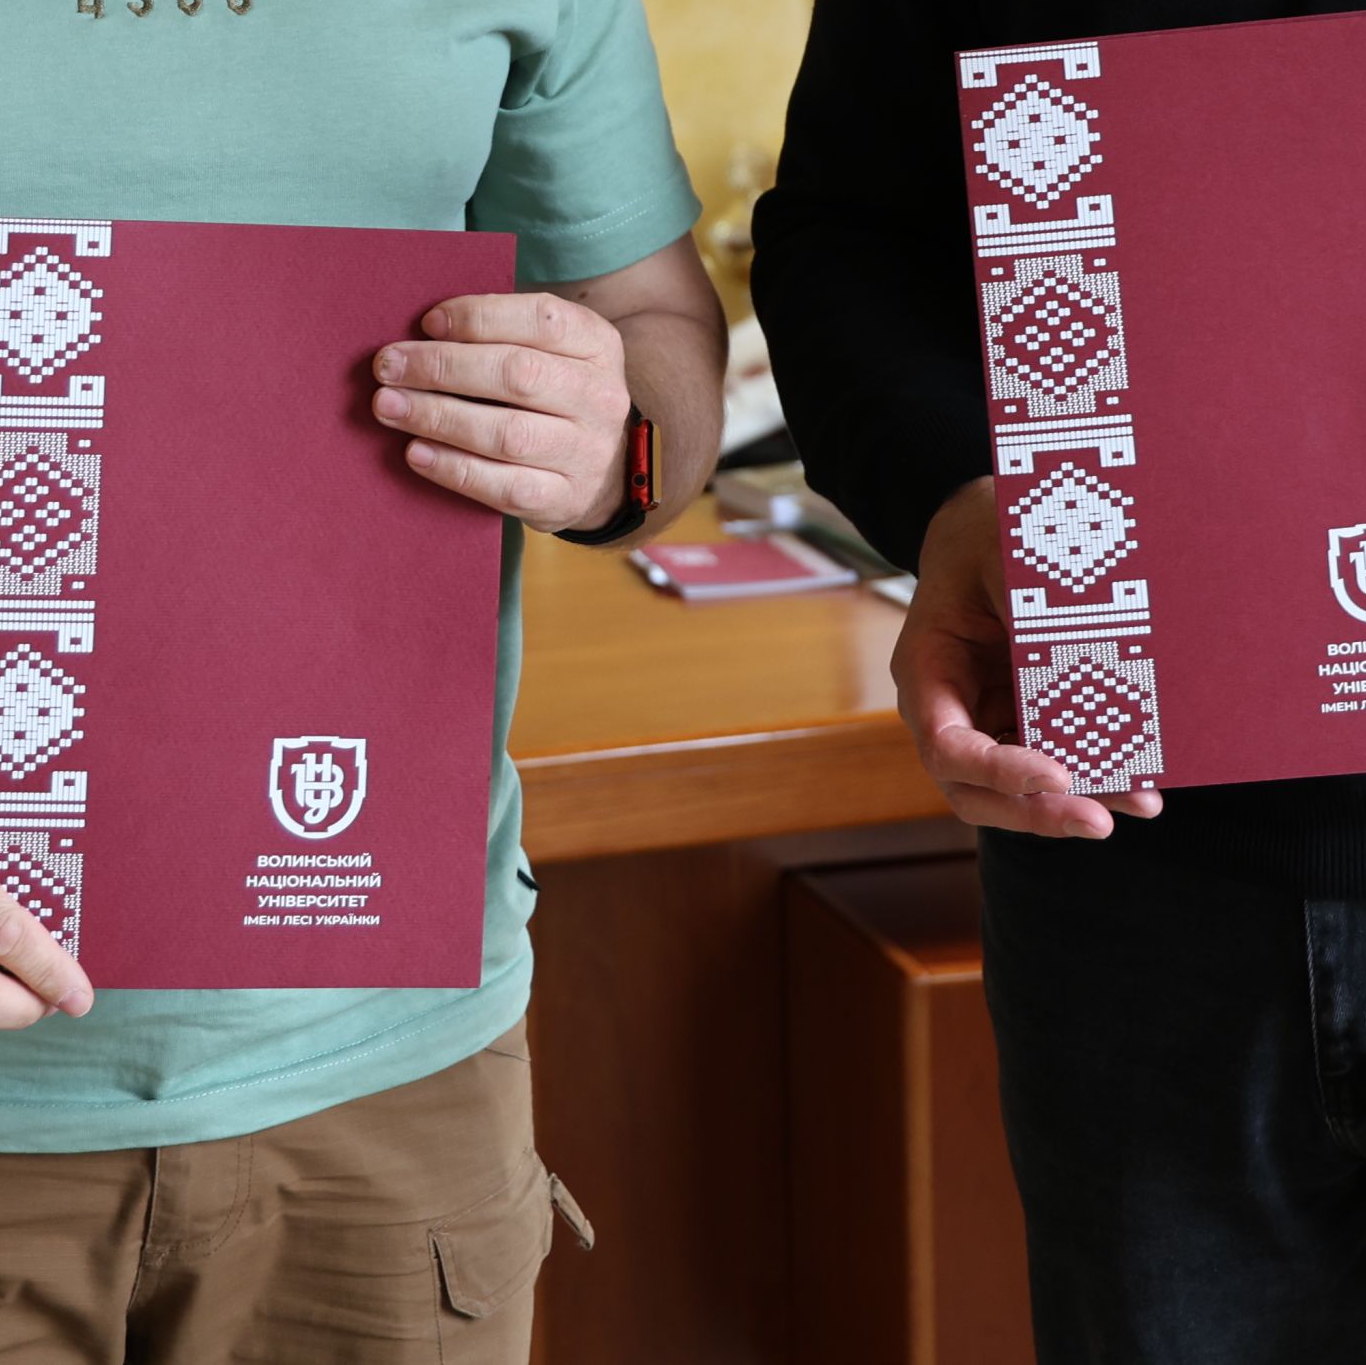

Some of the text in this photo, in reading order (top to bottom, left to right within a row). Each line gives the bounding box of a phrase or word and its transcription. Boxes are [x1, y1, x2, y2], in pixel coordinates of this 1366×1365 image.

[1321, 702, 1358, 713] ІМЕНІ
[257, 852, 372, 868] ВОЛИНСЬКИЙ
[245, 872, 381, 889] НАЦІОНАЛЬНИЙ
[258, 895, 368, 908] УНІВЕРСИТЕТ
[243, 913, 380, 926] ІМЕНІ ЛЕСІ УКРАЇНКИ
